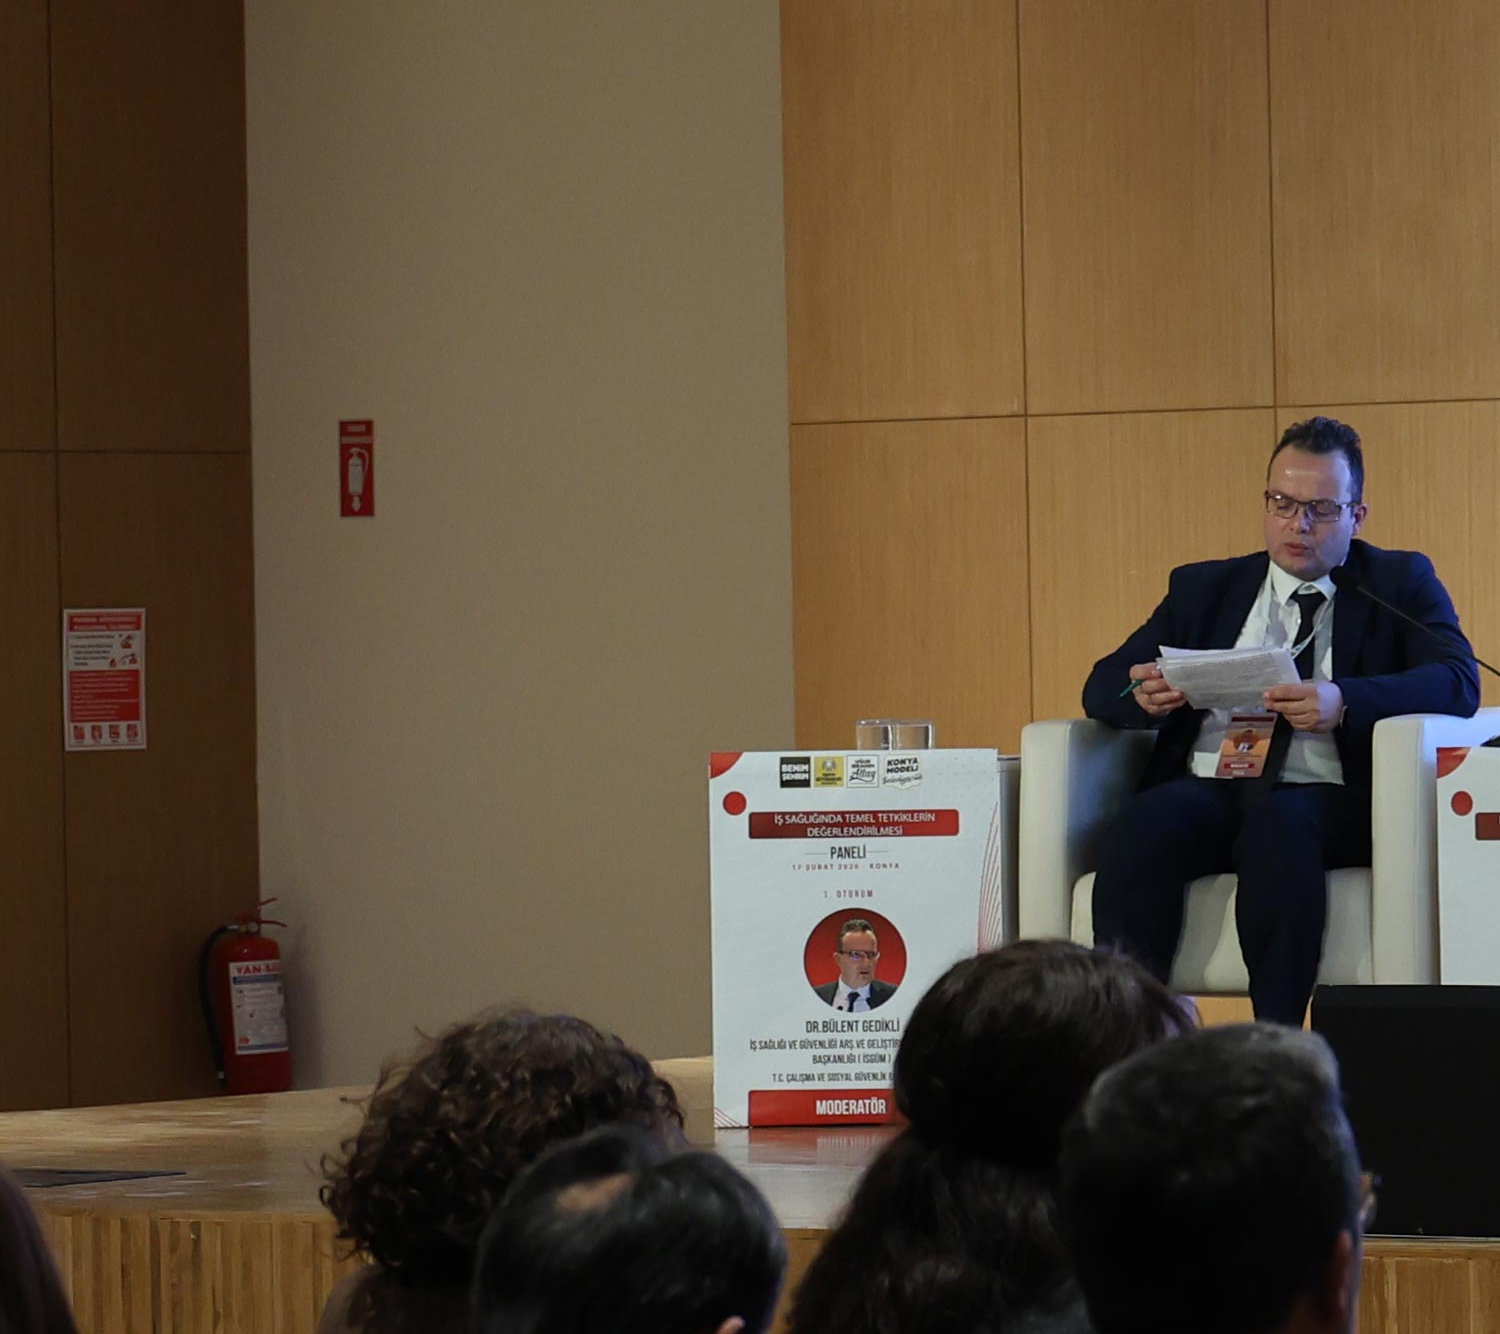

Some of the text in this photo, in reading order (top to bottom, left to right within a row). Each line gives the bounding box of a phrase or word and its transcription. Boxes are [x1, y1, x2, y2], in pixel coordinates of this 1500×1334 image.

[775, 811, 936, 826] İŞ SAĞLIĞINDA TEMEL TETKİKLERİN
[807, 825, 903, 837] DEĞERLENDİRİLMESİ
[830, 844, 866, 859] PANELİ
[862, 1017, 900, 1033] GEDİKLİ
[750, 1039, 757, 1052] İŞ
[788, 1040, 797, 1050] VE
[854, 1039, 865, 1049] VE
[816, 1097, 886, 1115] MODERATÖR
